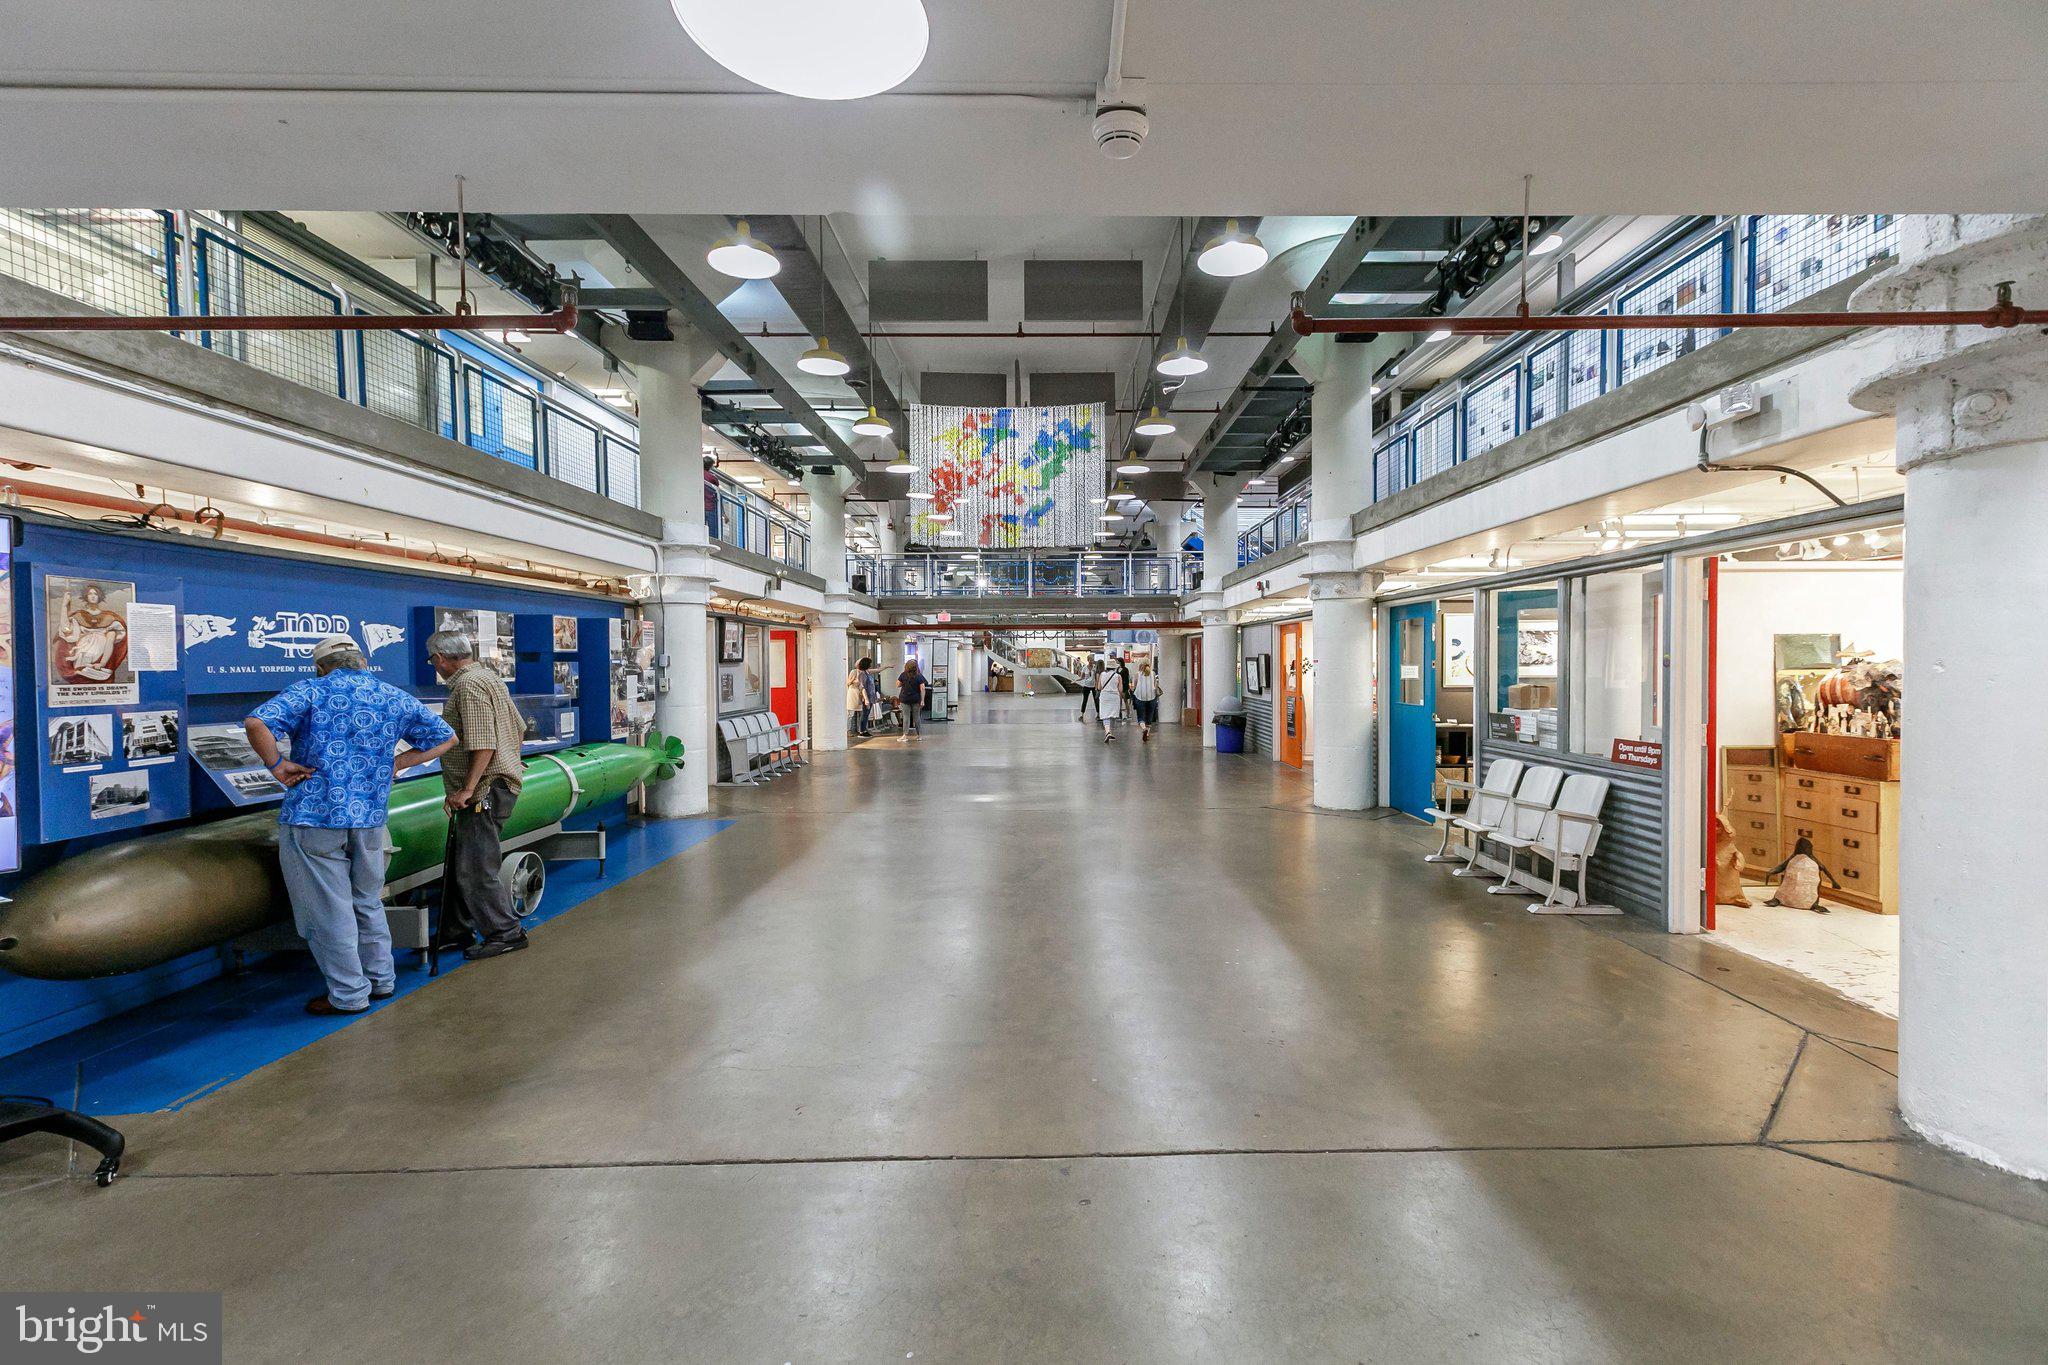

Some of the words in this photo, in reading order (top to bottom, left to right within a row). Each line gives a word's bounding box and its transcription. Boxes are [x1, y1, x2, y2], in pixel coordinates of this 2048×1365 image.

[252, 615, 277, 631] The
[260, 665, 295, 673] TORPEDO
[1618, 743, 1633, 752] Open
[1634, 745, 1647, 753] until
[1647, 746, 1661, 755] 9pm
[1627, 753, 1657, 765] Thursdays
